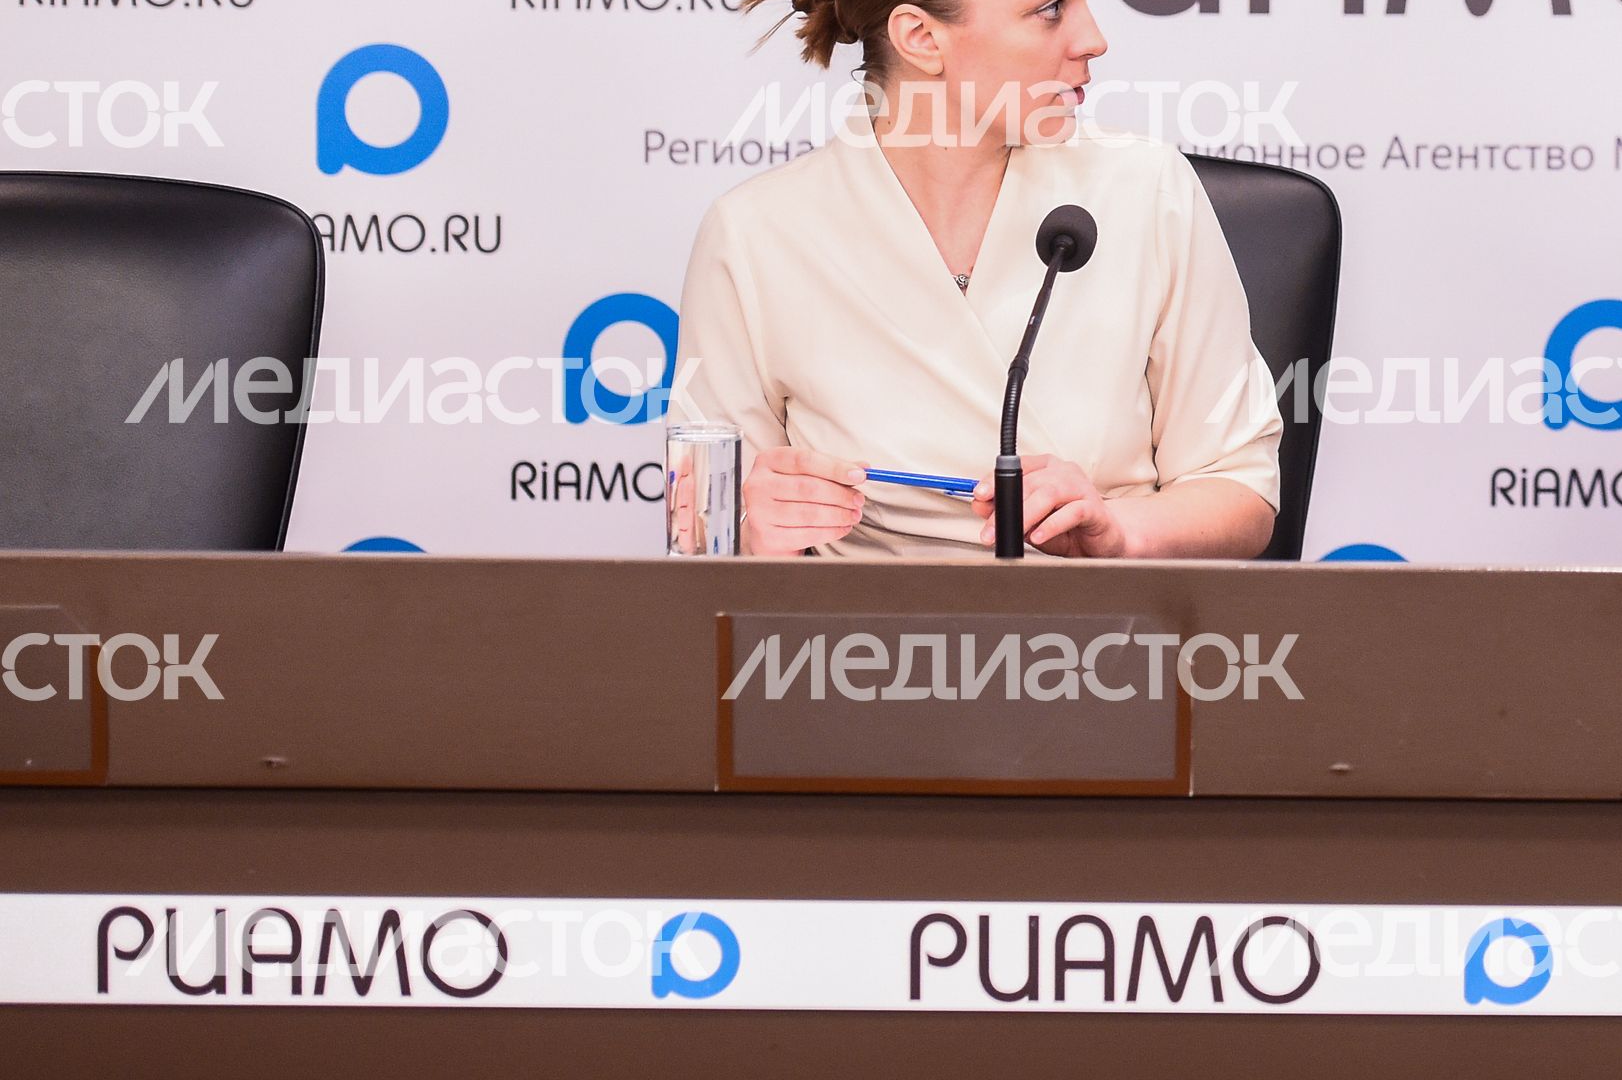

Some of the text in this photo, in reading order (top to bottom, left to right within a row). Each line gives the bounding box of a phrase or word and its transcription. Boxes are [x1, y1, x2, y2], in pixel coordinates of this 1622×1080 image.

[1381, 136, 1595, 171] Агентство
[97, 906, 508, 999] РИАМО
[909, 913, 1321, 1005] РИАМО
